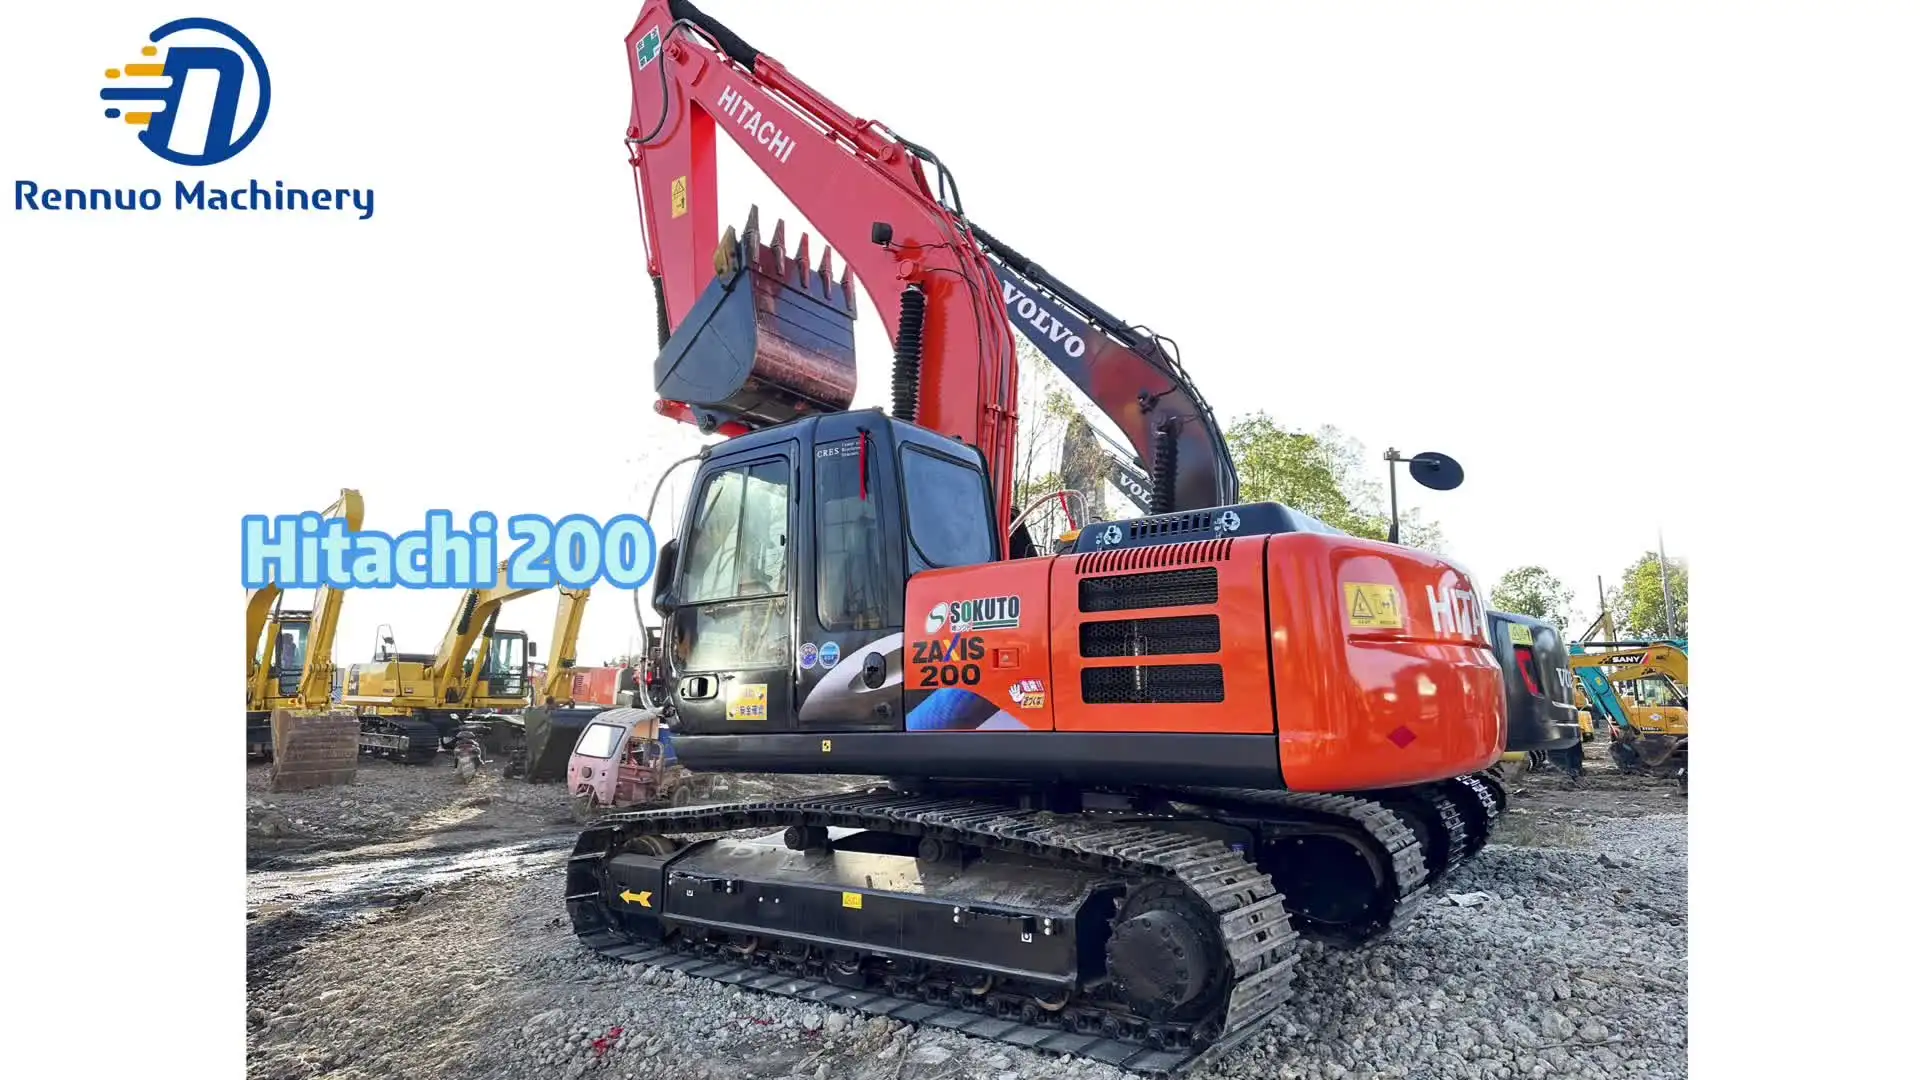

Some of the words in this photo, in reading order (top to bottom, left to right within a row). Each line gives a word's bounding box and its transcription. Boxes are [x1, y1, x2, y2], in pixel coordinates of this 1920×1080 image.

[717, 84, 797, 164] HITACHI
[1002, 280, 1085, 358] VOLVO
[816, 447, 840, 458] CRES
[950, 596, 1020, 624] SOKUTO
[912, 633, 985, 664] ZAXIS
[1612, 655, 1641, 663] SANY
[920, 664, 981, 687] 200
